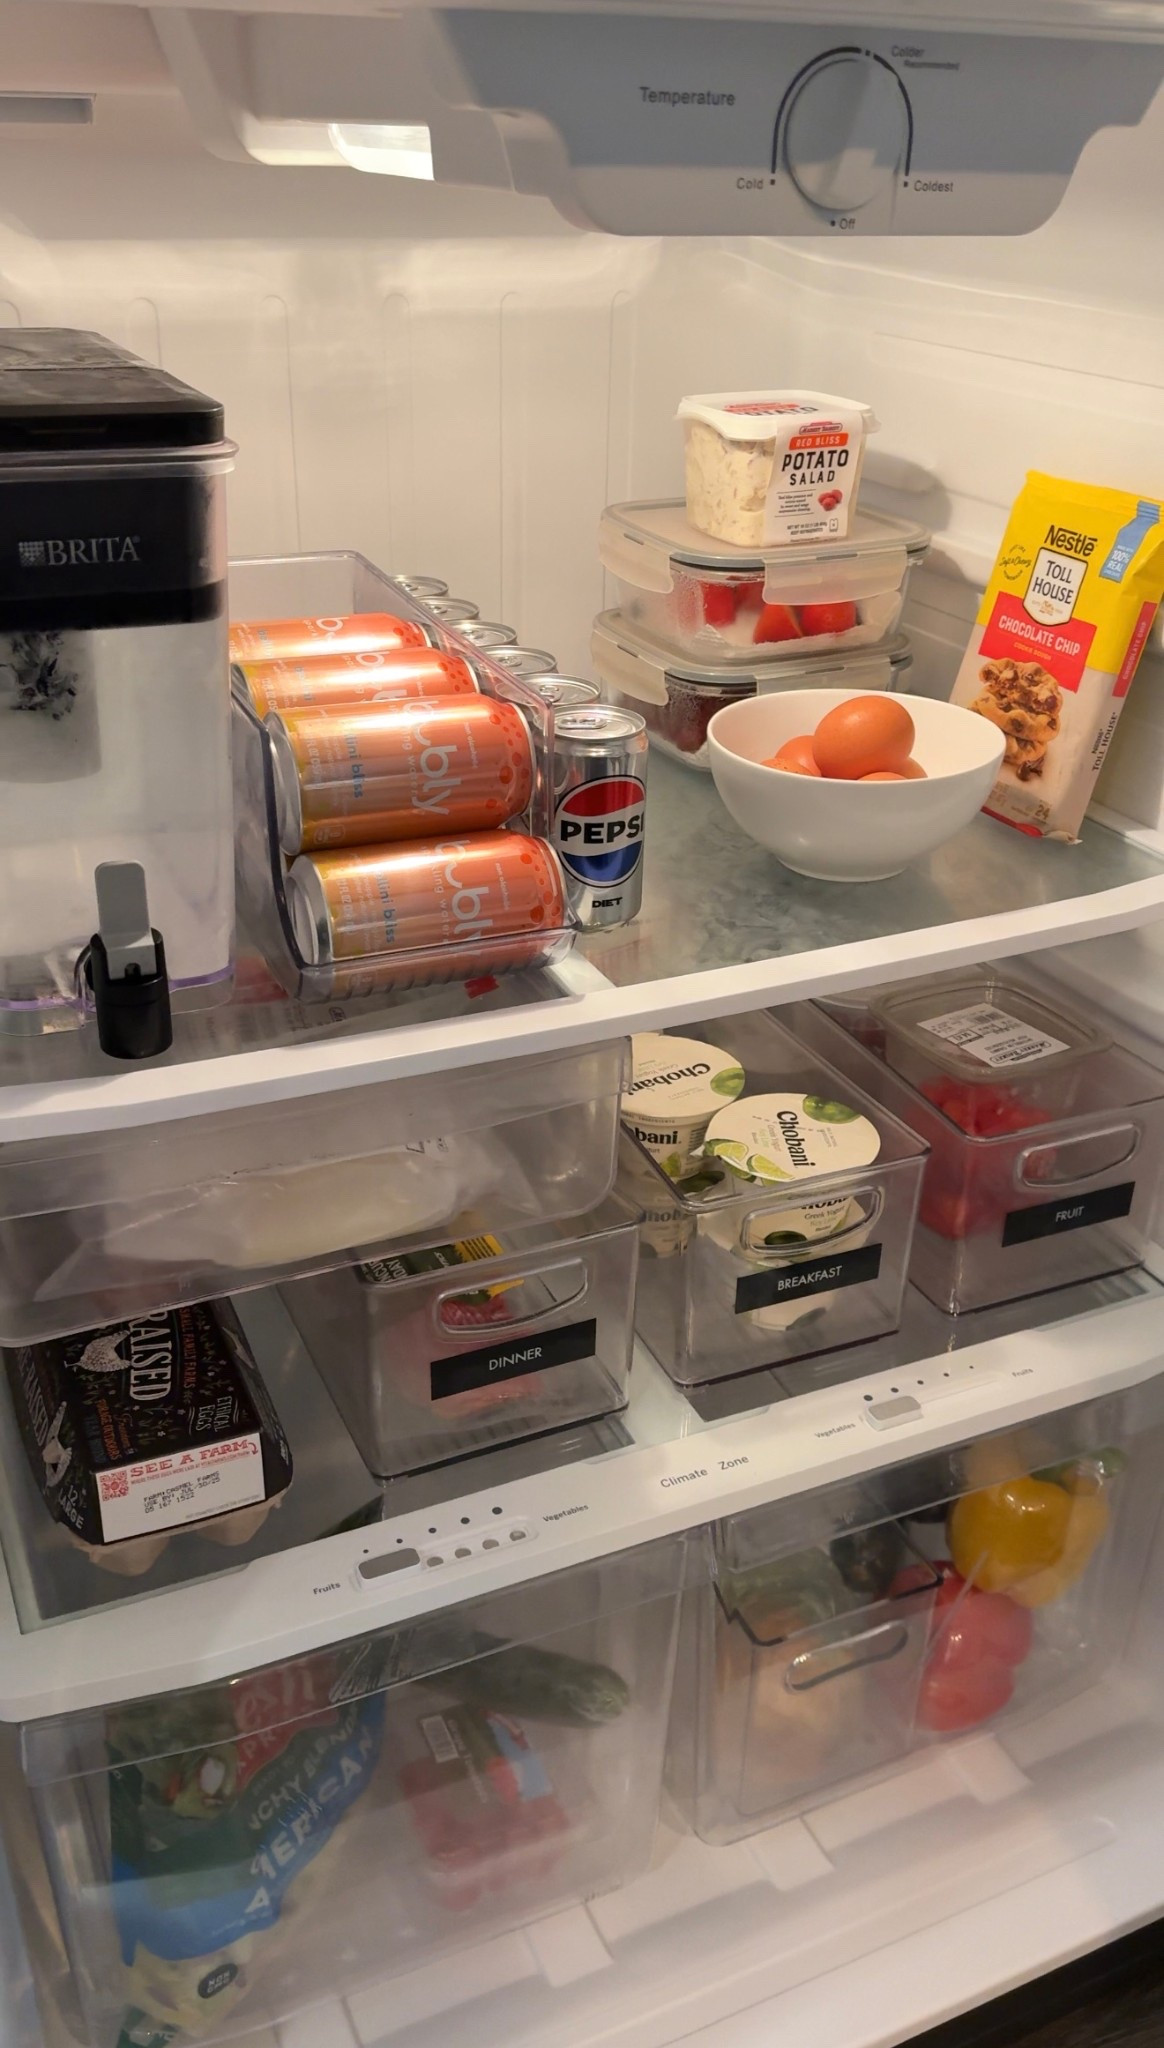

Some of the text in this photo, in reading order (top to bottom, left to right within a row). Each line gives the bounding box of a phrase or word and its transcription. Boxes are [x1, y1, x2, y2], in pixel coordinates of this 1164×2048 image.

[639, 86, 736, 107] Temperature
[736, 177, 764, 190] Cold
[913, 180, 954, 193] Coldest
[839, 217, 856, 230] Off
[796, 435, 841, 447] RED BLISS
[781, 449, 849, 472] POTATO
[789, 470, 836, 486] SALAD
[46, 536, 141, 566] BRITA
[1046, 560, 1073, 584] TOLL
[1032, 576, 1074, 605] HOUSE
[998, 614, 1080, 656] CHOCOLATE CHIP
[1092, 712, 1117, 771] TOLL HOUSE
[402, 699, 463, 816] bubly
[351, 764, 366, 798] bliss
[375, 870, 398, 943] ellini bliss
[592, 896, 623, 909] DIET
[628, 1062, 712, 1096] Choban
[776, 1110, 816, 1168] Chobani
[1055, 1205, 1085, 1222] FRUIT
[777, 1265, 843, 1291] BREAKFAST
[488, 1347, 542, 1371] DINNER
[183, 1361, 197, 1389] FARMS
[1011, 1367, 1034, 1379] Fruits
[195, 1404, 215, 1431] EGGS
[213, 1395, 233, 1433] ETHICAL
[814, 1421, 856, 1440] Vegetables
[130, 1439, 249, 1478] SEE A FARM
[197, 1470, 220, 1482] FARMS
[660, 1454, 750, 1489] Climate Zone
[58, 1487, 85, 1530] LARGE
[144, 1499, 158, 1508] USE
[542, 1503, 590, 1523] Vegetables
[312, 1581, 341, 1596] Fruits
